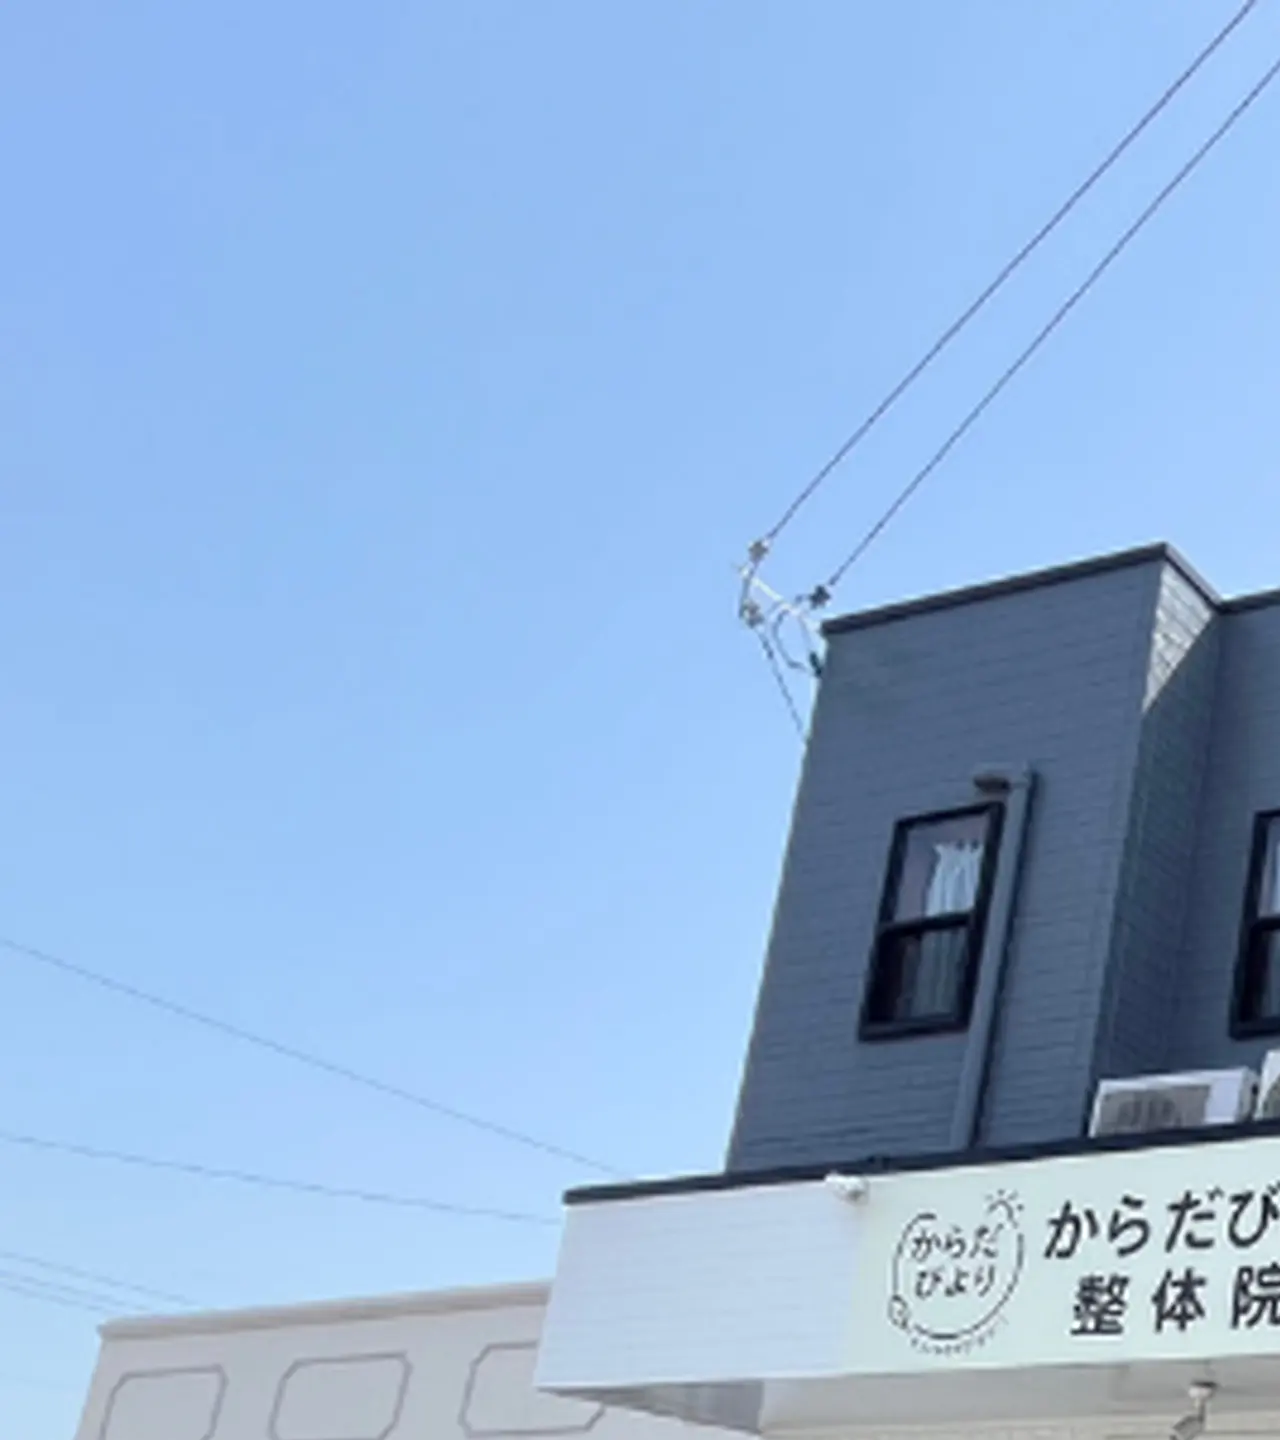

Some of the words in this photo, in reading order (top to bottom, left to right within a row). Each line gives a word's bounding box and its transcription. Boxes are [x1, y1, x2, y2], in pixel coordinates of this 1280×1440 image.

[909, 1223, 1004, 1261] からだ
[914, 1263, 999, 1300] びより
